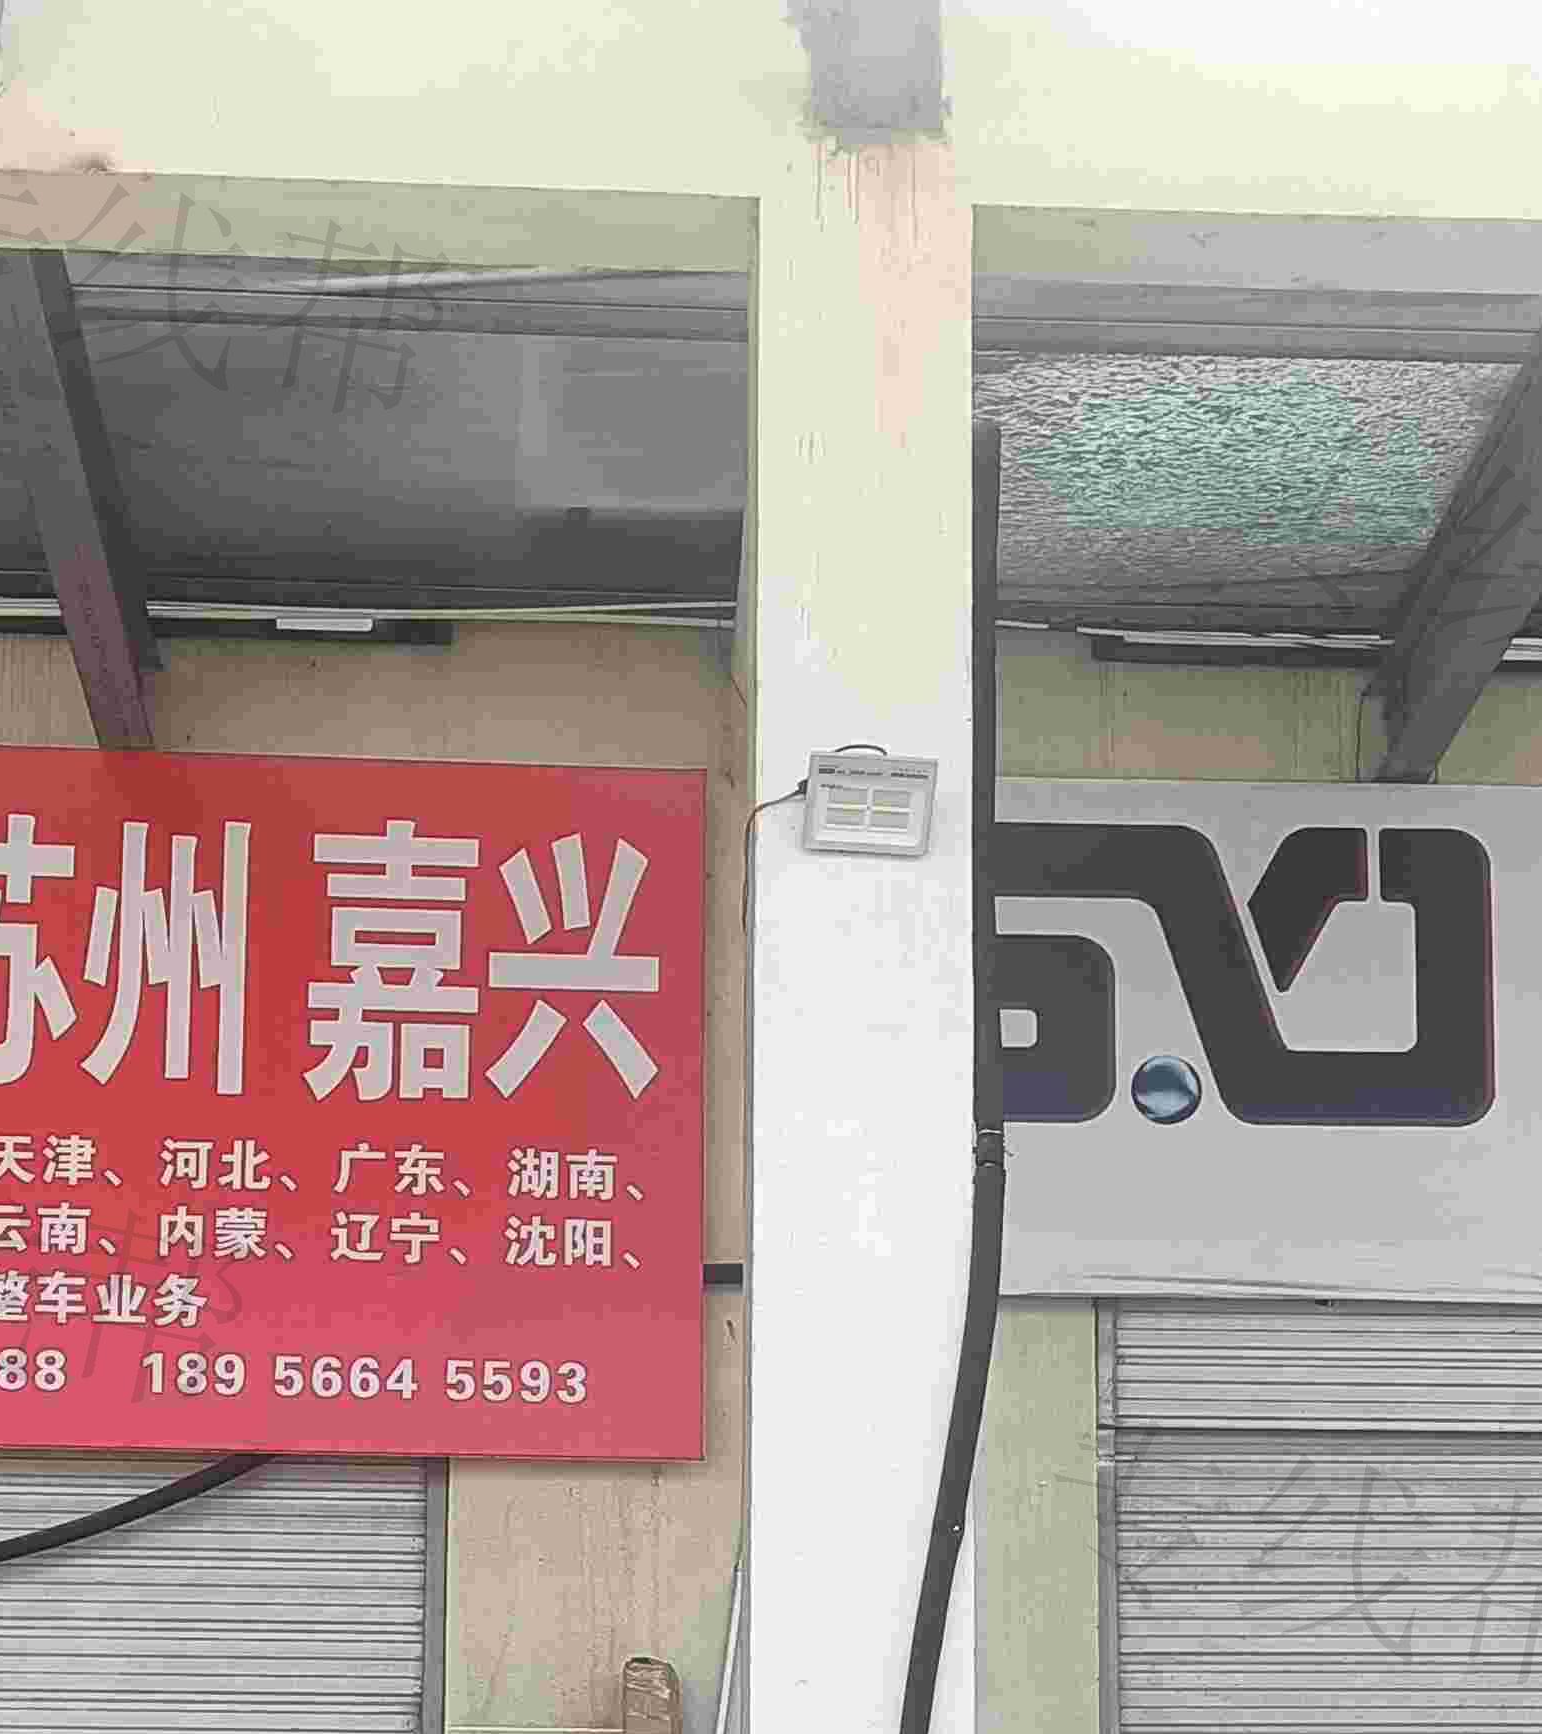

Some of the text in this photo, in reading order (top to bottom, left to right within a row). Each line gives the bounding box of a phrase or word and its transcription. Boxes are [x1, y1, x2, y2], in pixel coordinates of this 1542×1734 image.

[303, 820, 661, 1101] 嘉兴
[142, 1352, 246, 1395] 189
[273, 1355, 419, 1399] 5664
[445, 1359, 587, 1403] 5593
